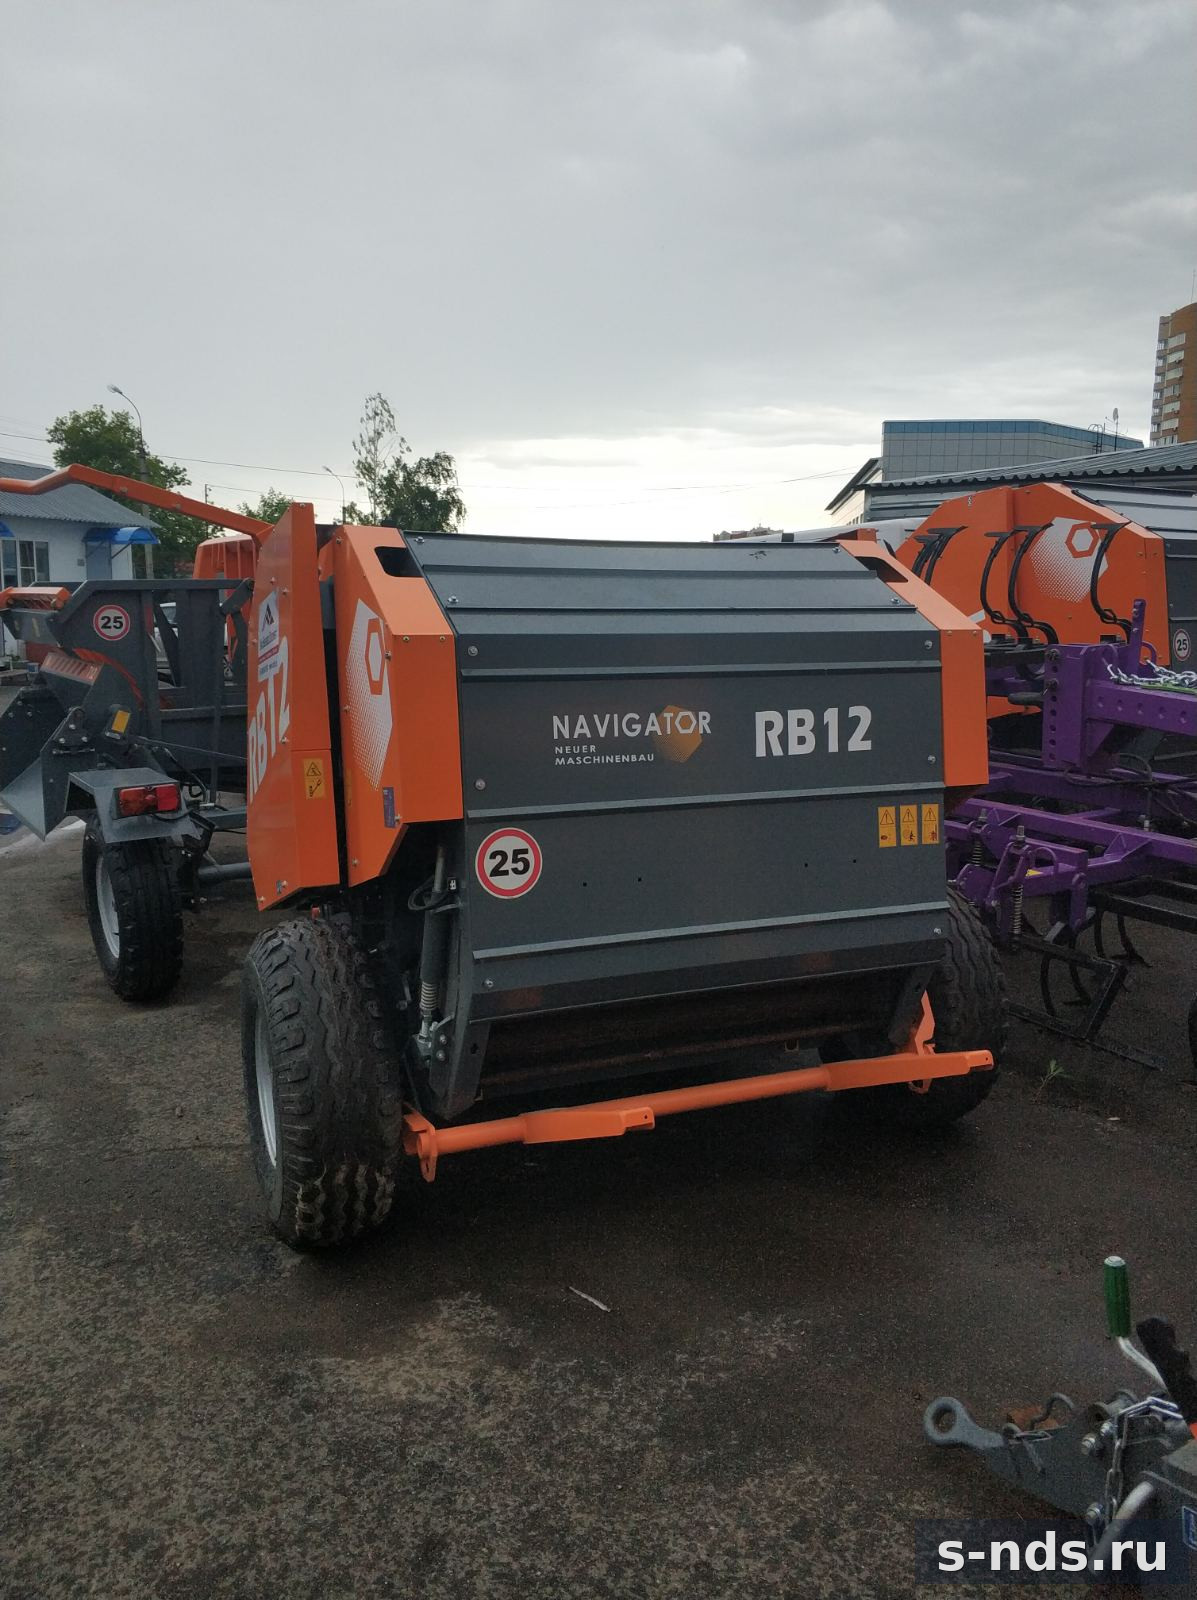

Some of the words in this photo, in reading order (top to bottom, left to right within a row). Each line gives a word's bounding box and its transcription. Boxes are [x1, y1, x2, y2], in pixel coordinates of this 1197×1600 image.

[100, 616, 124, 630] 25
[1176, 638, 1188, 651] 25
[552, 710, 712, 740] NAVIGATOR
[755, 704, 873, 758] RB12
[554, 744, 597, 755] NEUER
[554, 753, 655, 766] MASCHINENBAU
[488, 847, 531, 878] 25
